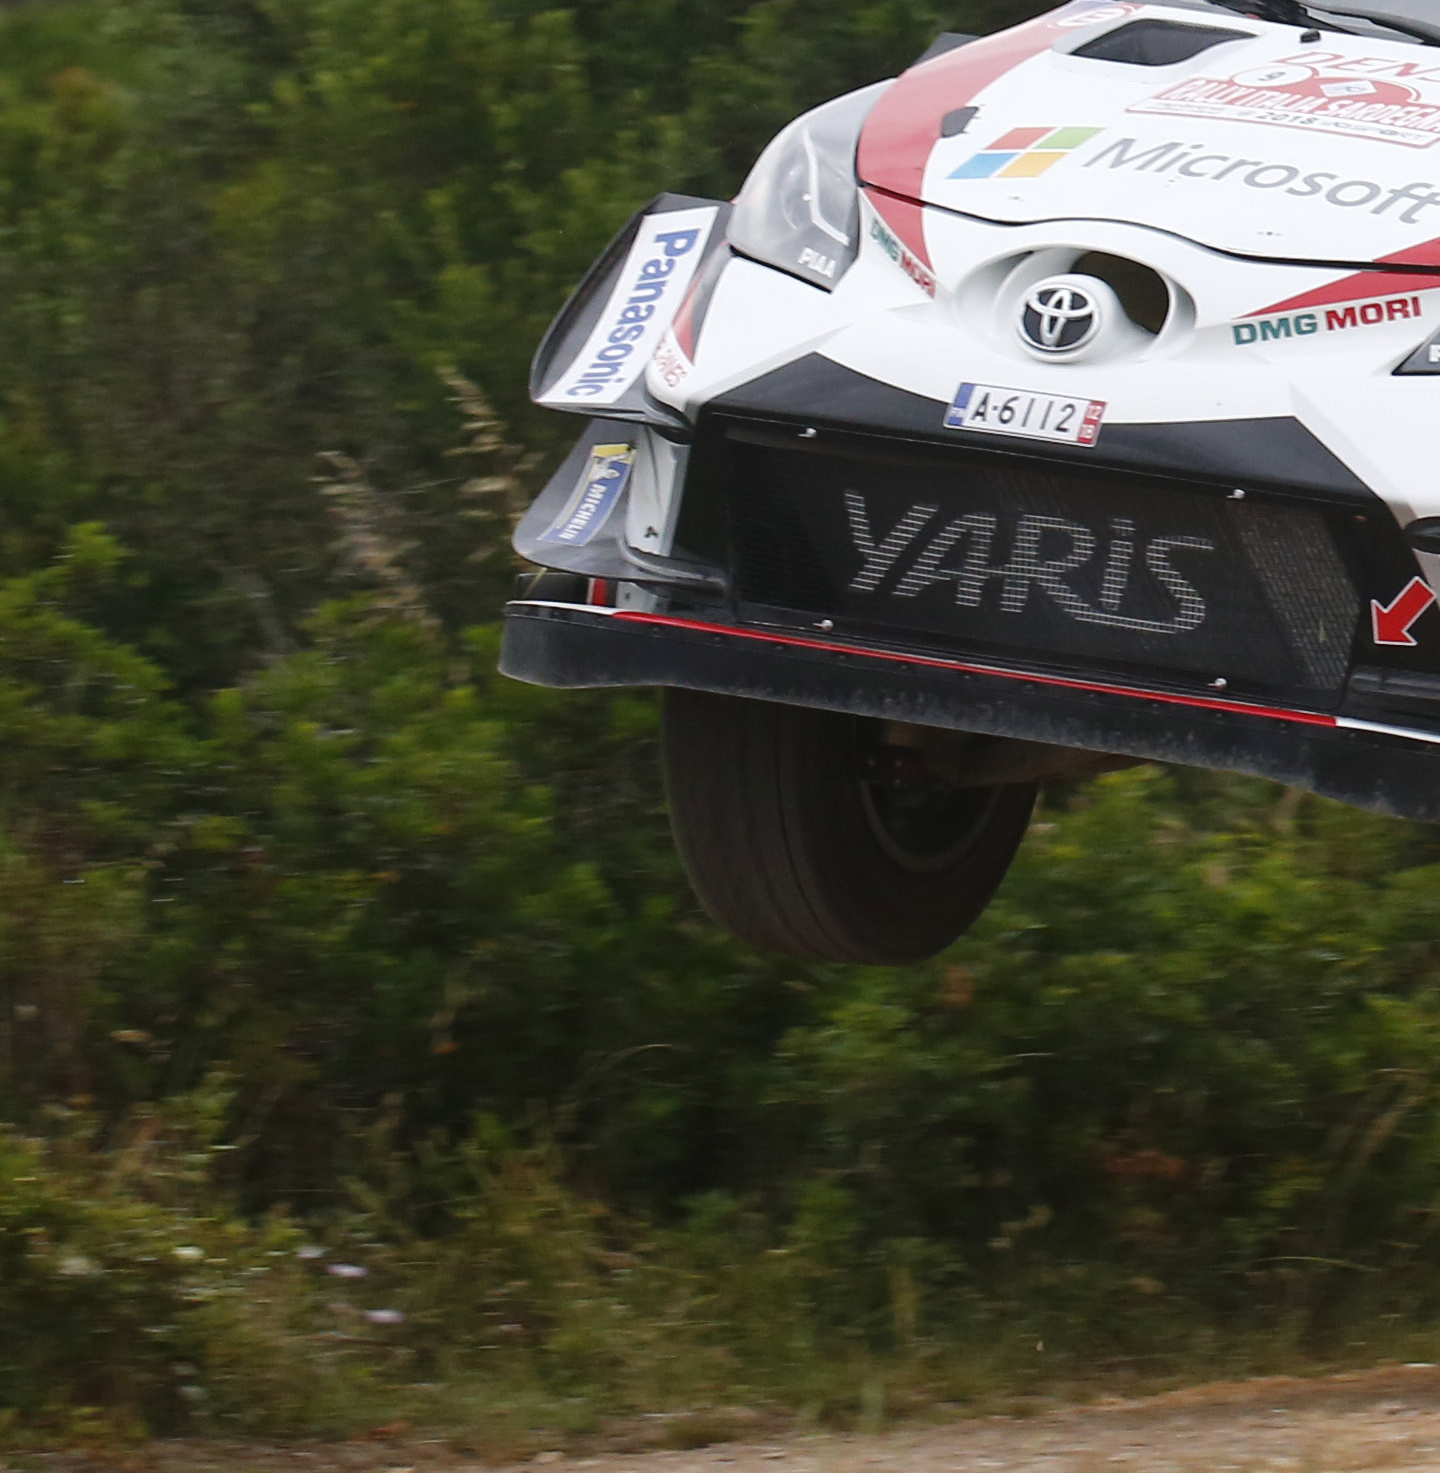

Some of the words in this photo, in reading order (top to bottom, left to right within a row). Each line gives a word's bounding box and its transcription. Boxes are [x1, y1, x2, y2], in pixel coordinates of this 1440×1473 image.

[566, 228, 702, 398] Panasonic
[1231, 312, 1319, 347] DMG
[1325, 296, 1423, 330] MORI
[558, 482, 608, 542] MICHELIN
